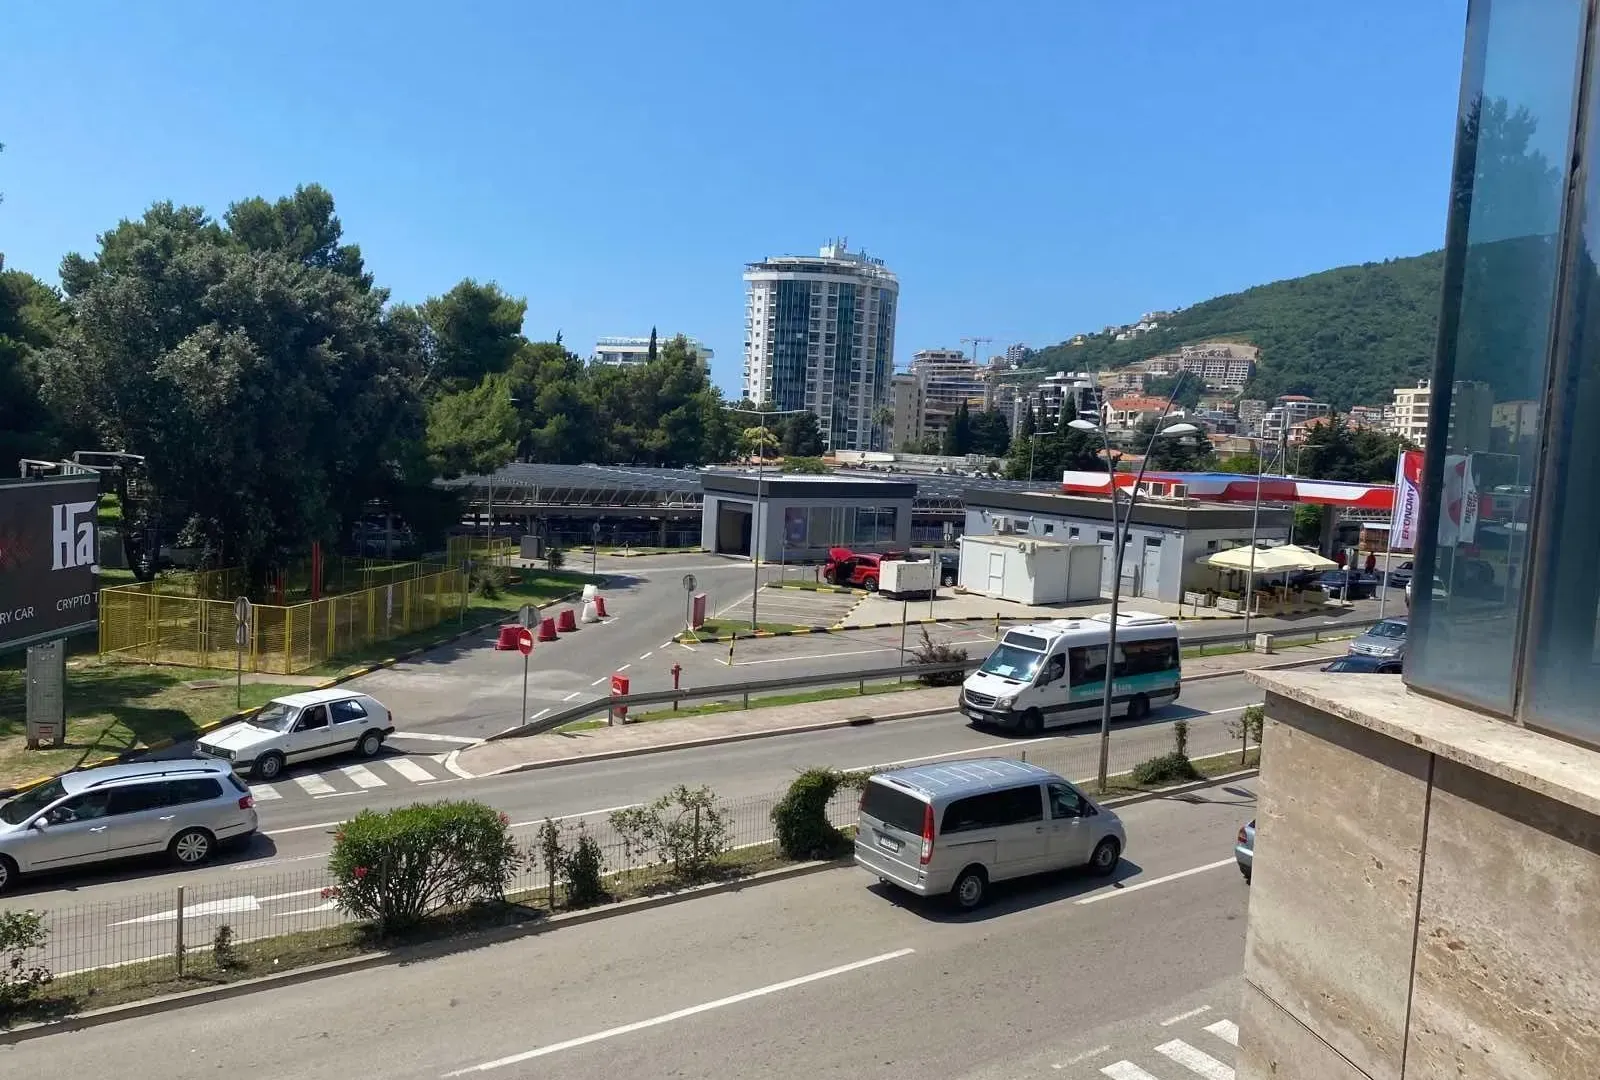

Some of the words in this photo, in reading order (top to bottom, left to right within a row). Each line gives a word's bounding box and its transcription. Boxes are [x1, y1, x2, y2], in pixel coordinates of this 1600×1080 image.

[1402, 486, 1415, 540] EKONOMY
[56, 594, 91, 612] CRYPTO
[15, 606, 34, 621] CAR
